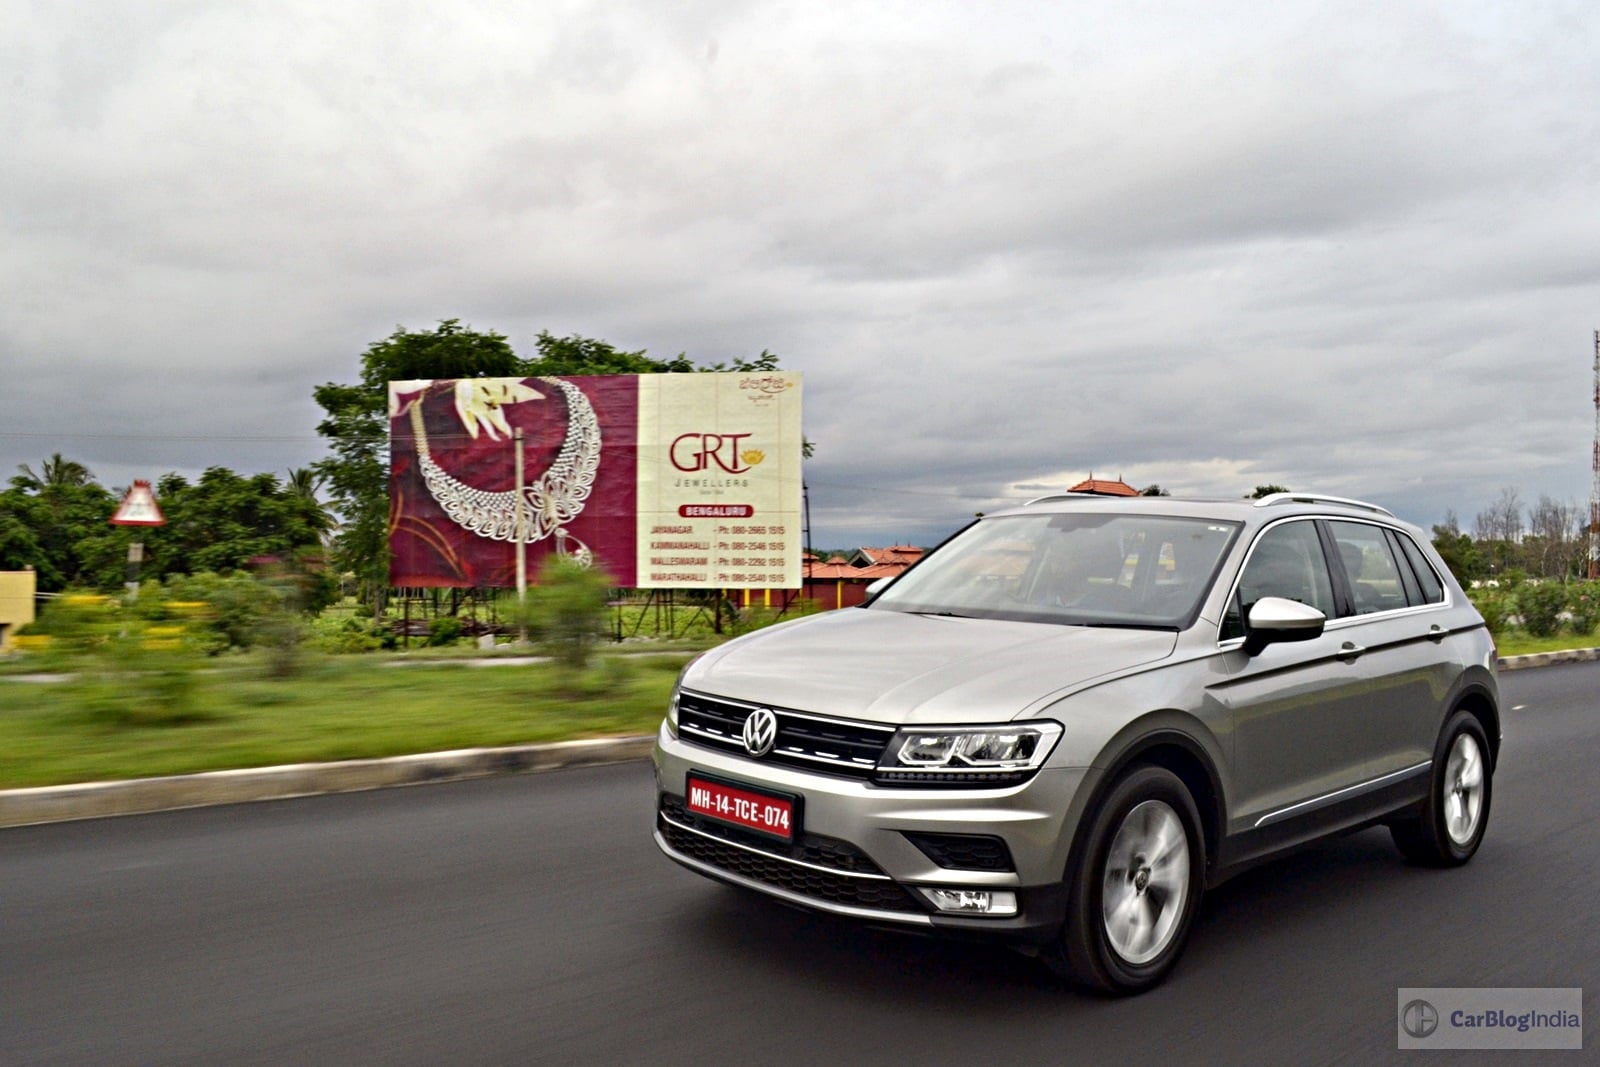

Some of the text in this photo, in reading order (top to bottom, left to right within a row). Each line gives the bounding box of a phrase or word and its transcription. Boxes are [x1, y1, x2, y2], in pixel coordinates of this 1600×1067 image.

[669, 433, 752, 474] GRT
[674, 479, 748, 488] JEWELLERS
[685, 506, 747, 516] BENGALURU
[650, 526, 693, 534] JAYANAGAR
[768, 525, 785, 534] 1515
[768, 541, 785, 550] 1515
[768, 557, 785, 566] 1515
[768, 573, 785, 582] 1515
[691, 787, 790, 829] MH-14-TCE-074
